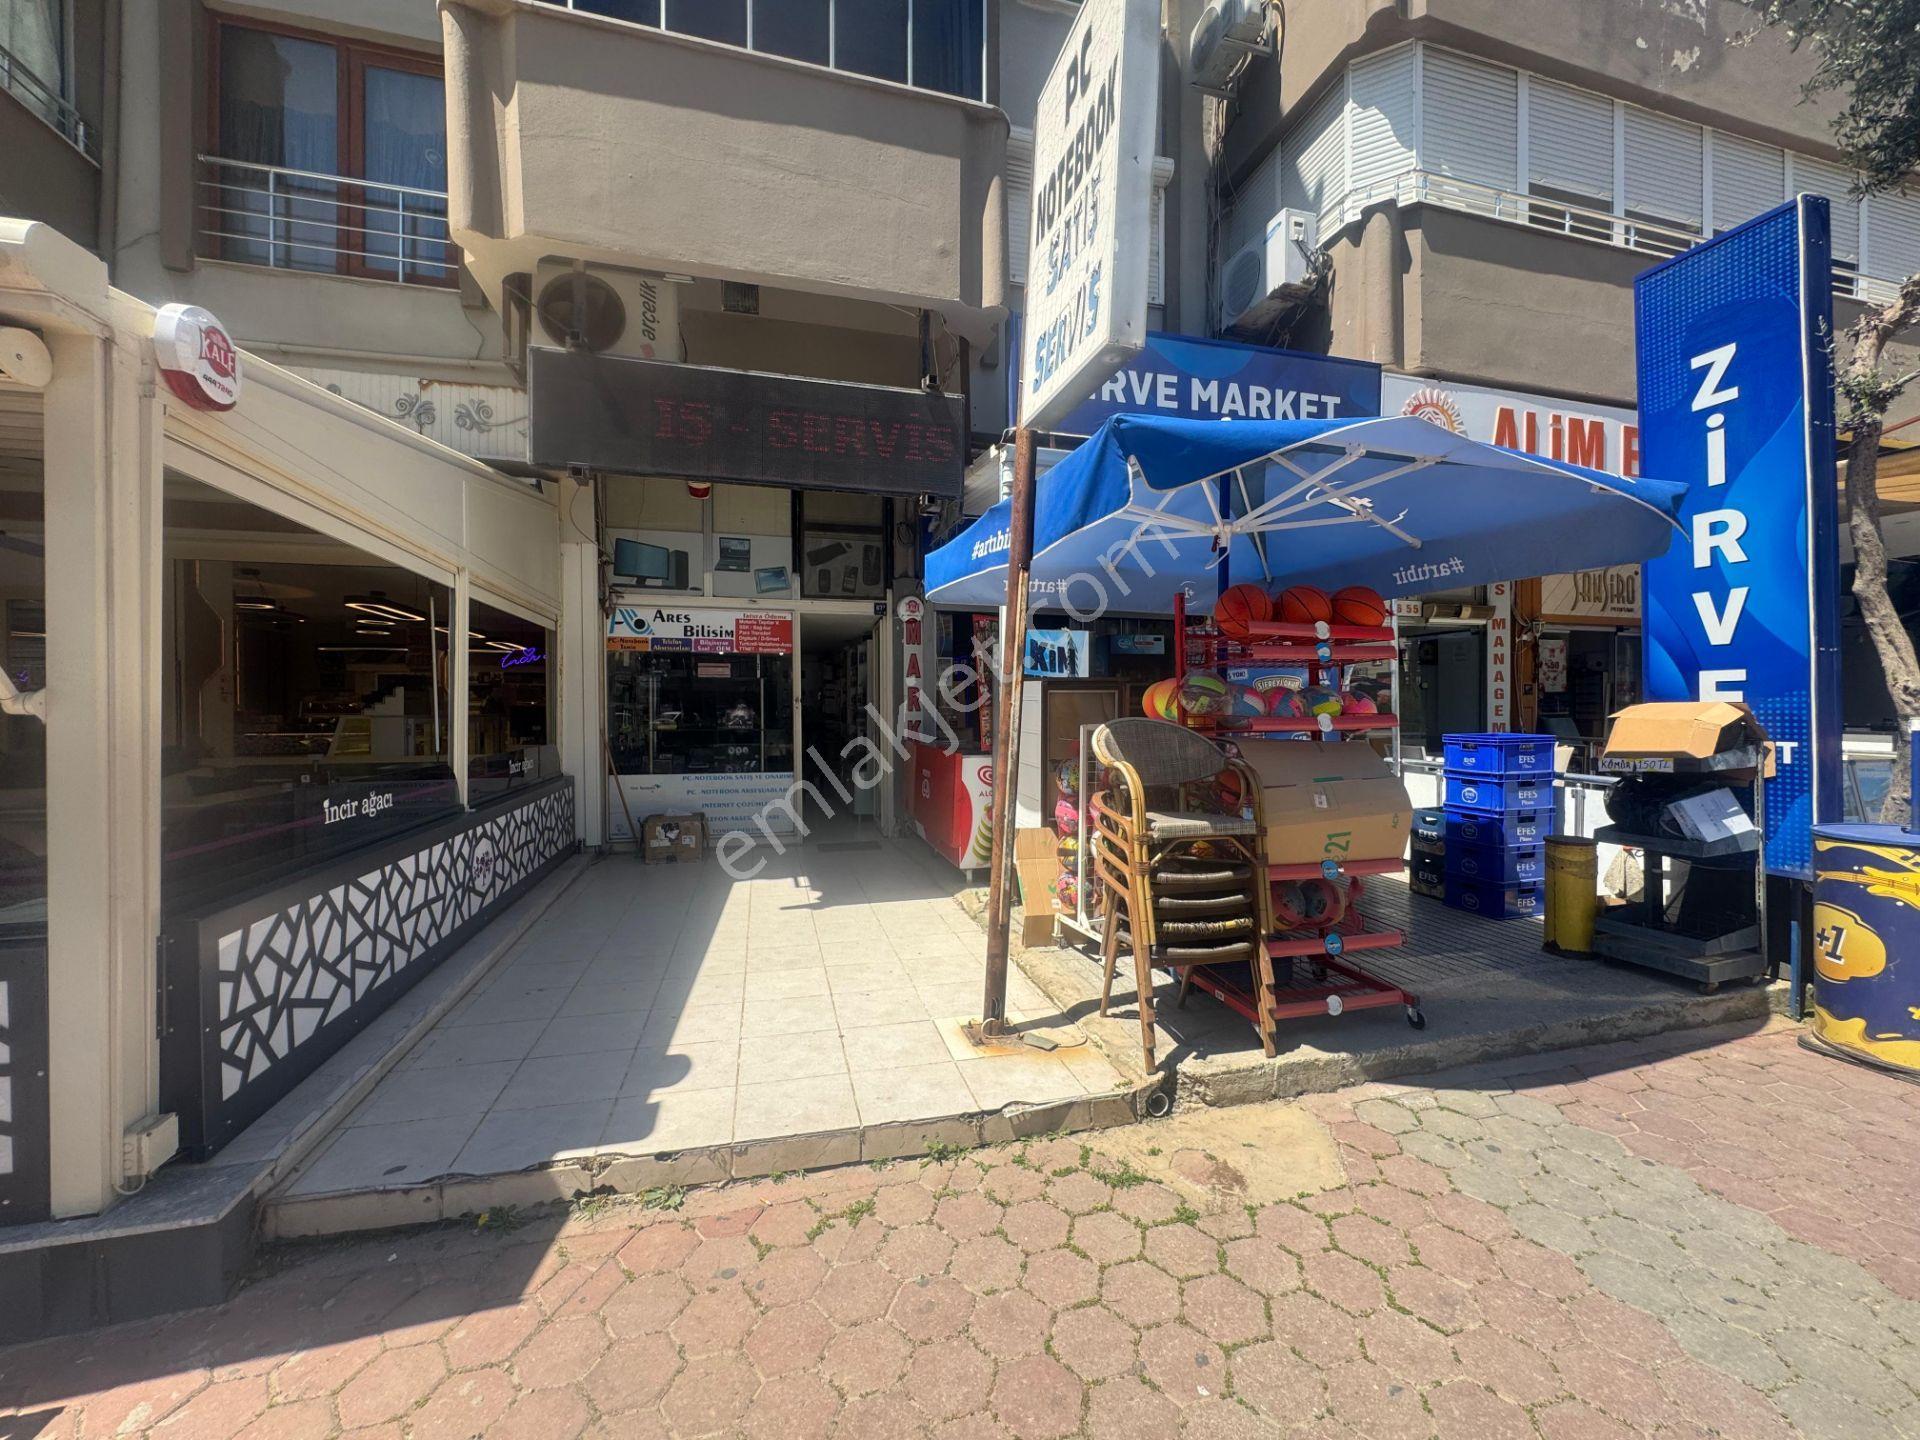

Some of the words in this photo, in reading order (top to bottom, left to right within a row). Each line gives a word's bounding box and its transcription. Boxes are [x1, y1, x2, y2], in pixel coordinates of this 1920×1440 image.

[1064, 23, 1093, 129] PC
[1035, 55, 1119, 246] NOTEBOOK
[640, 280, 660, 342] arçelik
[200, 331, 236, 378] KALE
[1190, 378, 1341, 420] MARKET
[1518, 755, 1536, 764] EFES
[1638, 760, 1656, 769] 150
[362, 791, 393, 817] ağacı
[1518, 790, 1538, 799] EFES
[1324, 831, 1352, 853] 21
[1418, 829, 1438, 839] EFES
[1516, 826, 1536, 836] EFES
[1516, 863, 1536, 873] EFES
[1517, 896, 1537, 907] EFES
[1816, 926, 1847, 965] +1
